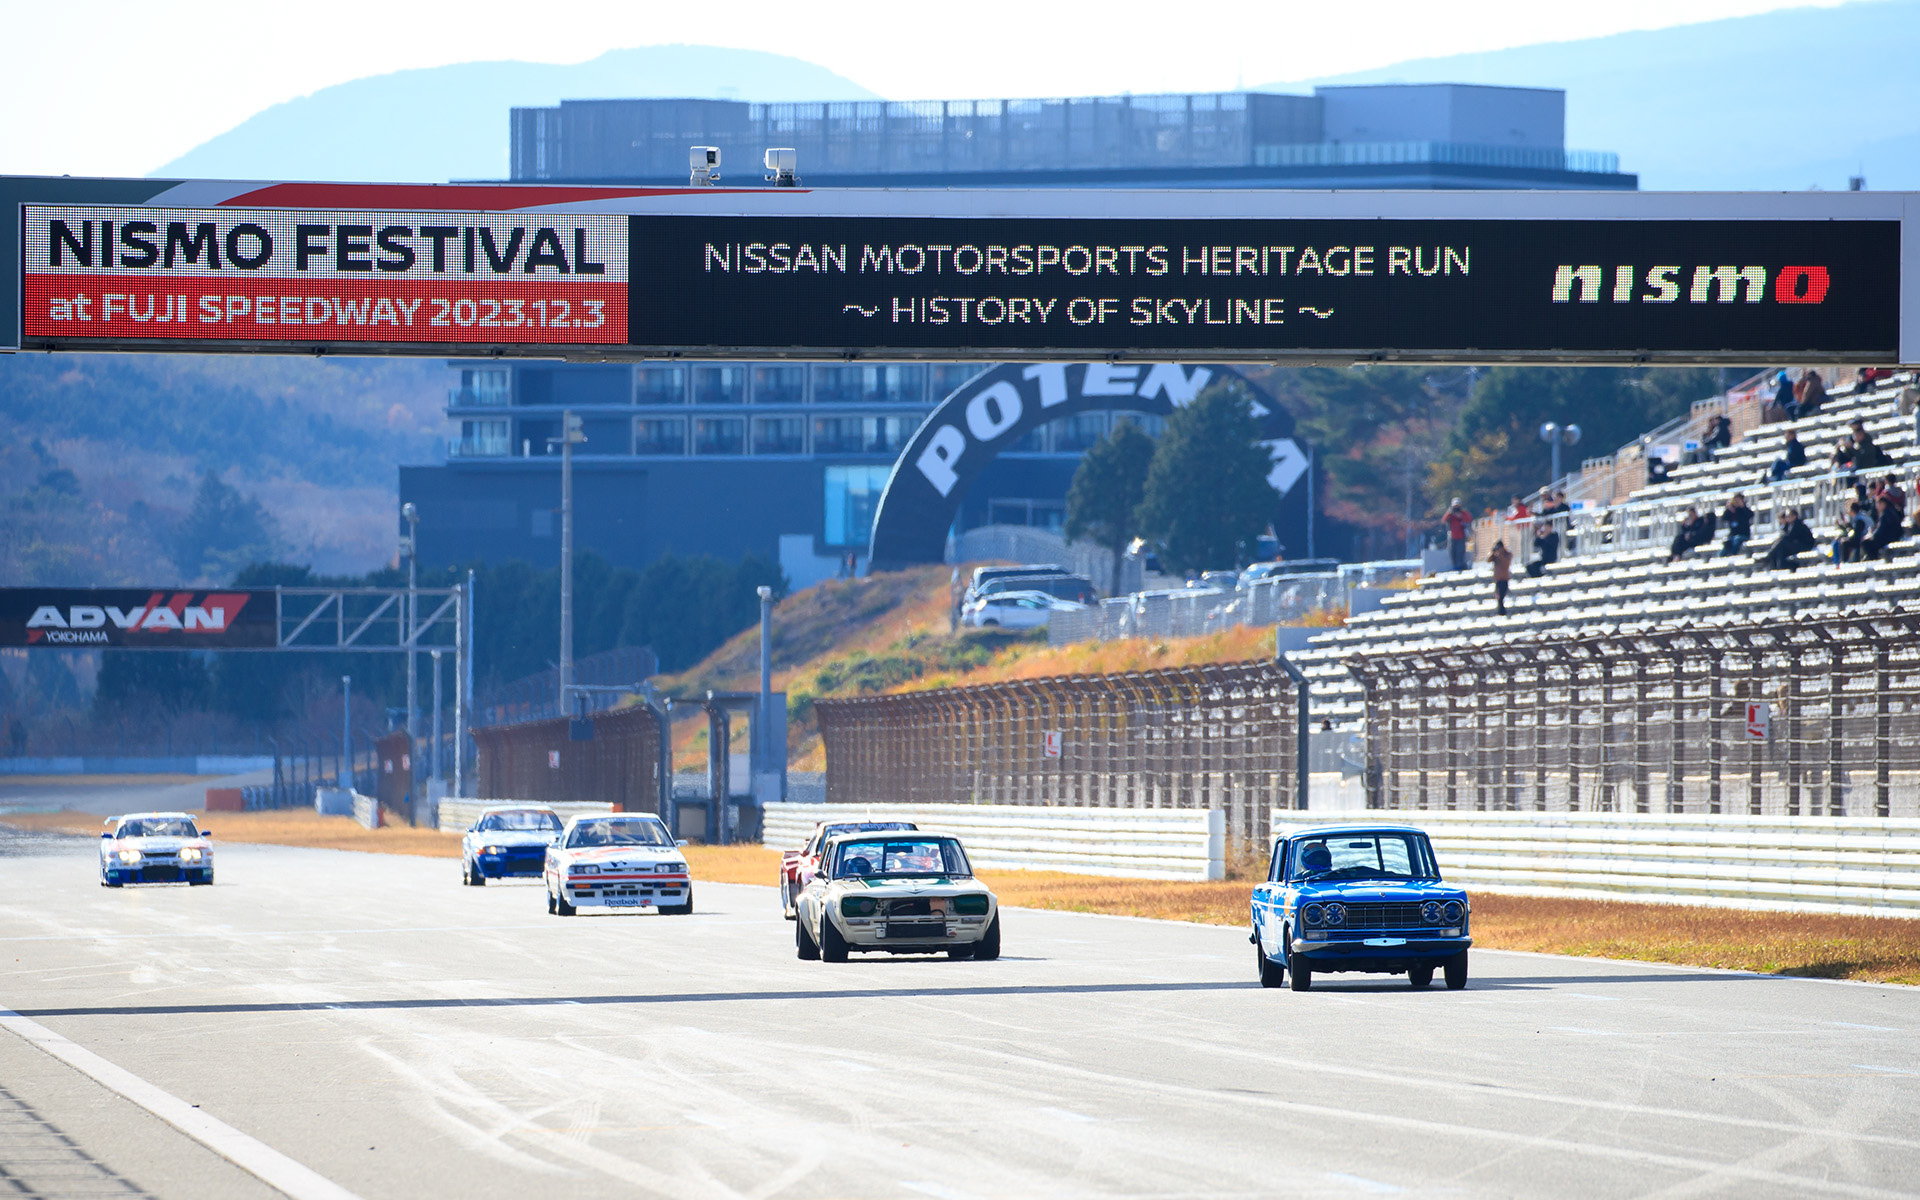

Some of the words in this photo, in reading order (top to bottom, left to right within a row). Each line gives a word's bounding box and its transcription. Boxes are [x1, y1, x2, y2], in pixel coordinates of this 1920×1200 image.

[50, 219, 273, 270] NISMO
[296, 224, 605, 275] FESTIVAL
[705, 243, 847, 274] NISSAN
[860, 244, 1170, 276] MOTORSPORTS
[1182, 245, 1375, 277] HERITAGE
[1388, 246, 1470, 276] RUN
[1552, 265, 1830, 304] nismo
[50, 293, 92, 322] at
[102, 293, 187, 323] FUJI
[199, 294, 423, 327] SPEEDWAY
[430, 297, 606, 330] 2023.12.3
[892, 296, 1058, 325] HISTORY
[1066, 296, 1119, 325] OF
[1130, 296, 1285, 326] SKYLINE
[915, 363, 1310, 499] POTENA
[26, 605, 225, 630] ADVAN
[45, 630, 109, 643] YOKOHAMA
[604, 898, 639, 906] Reebok
